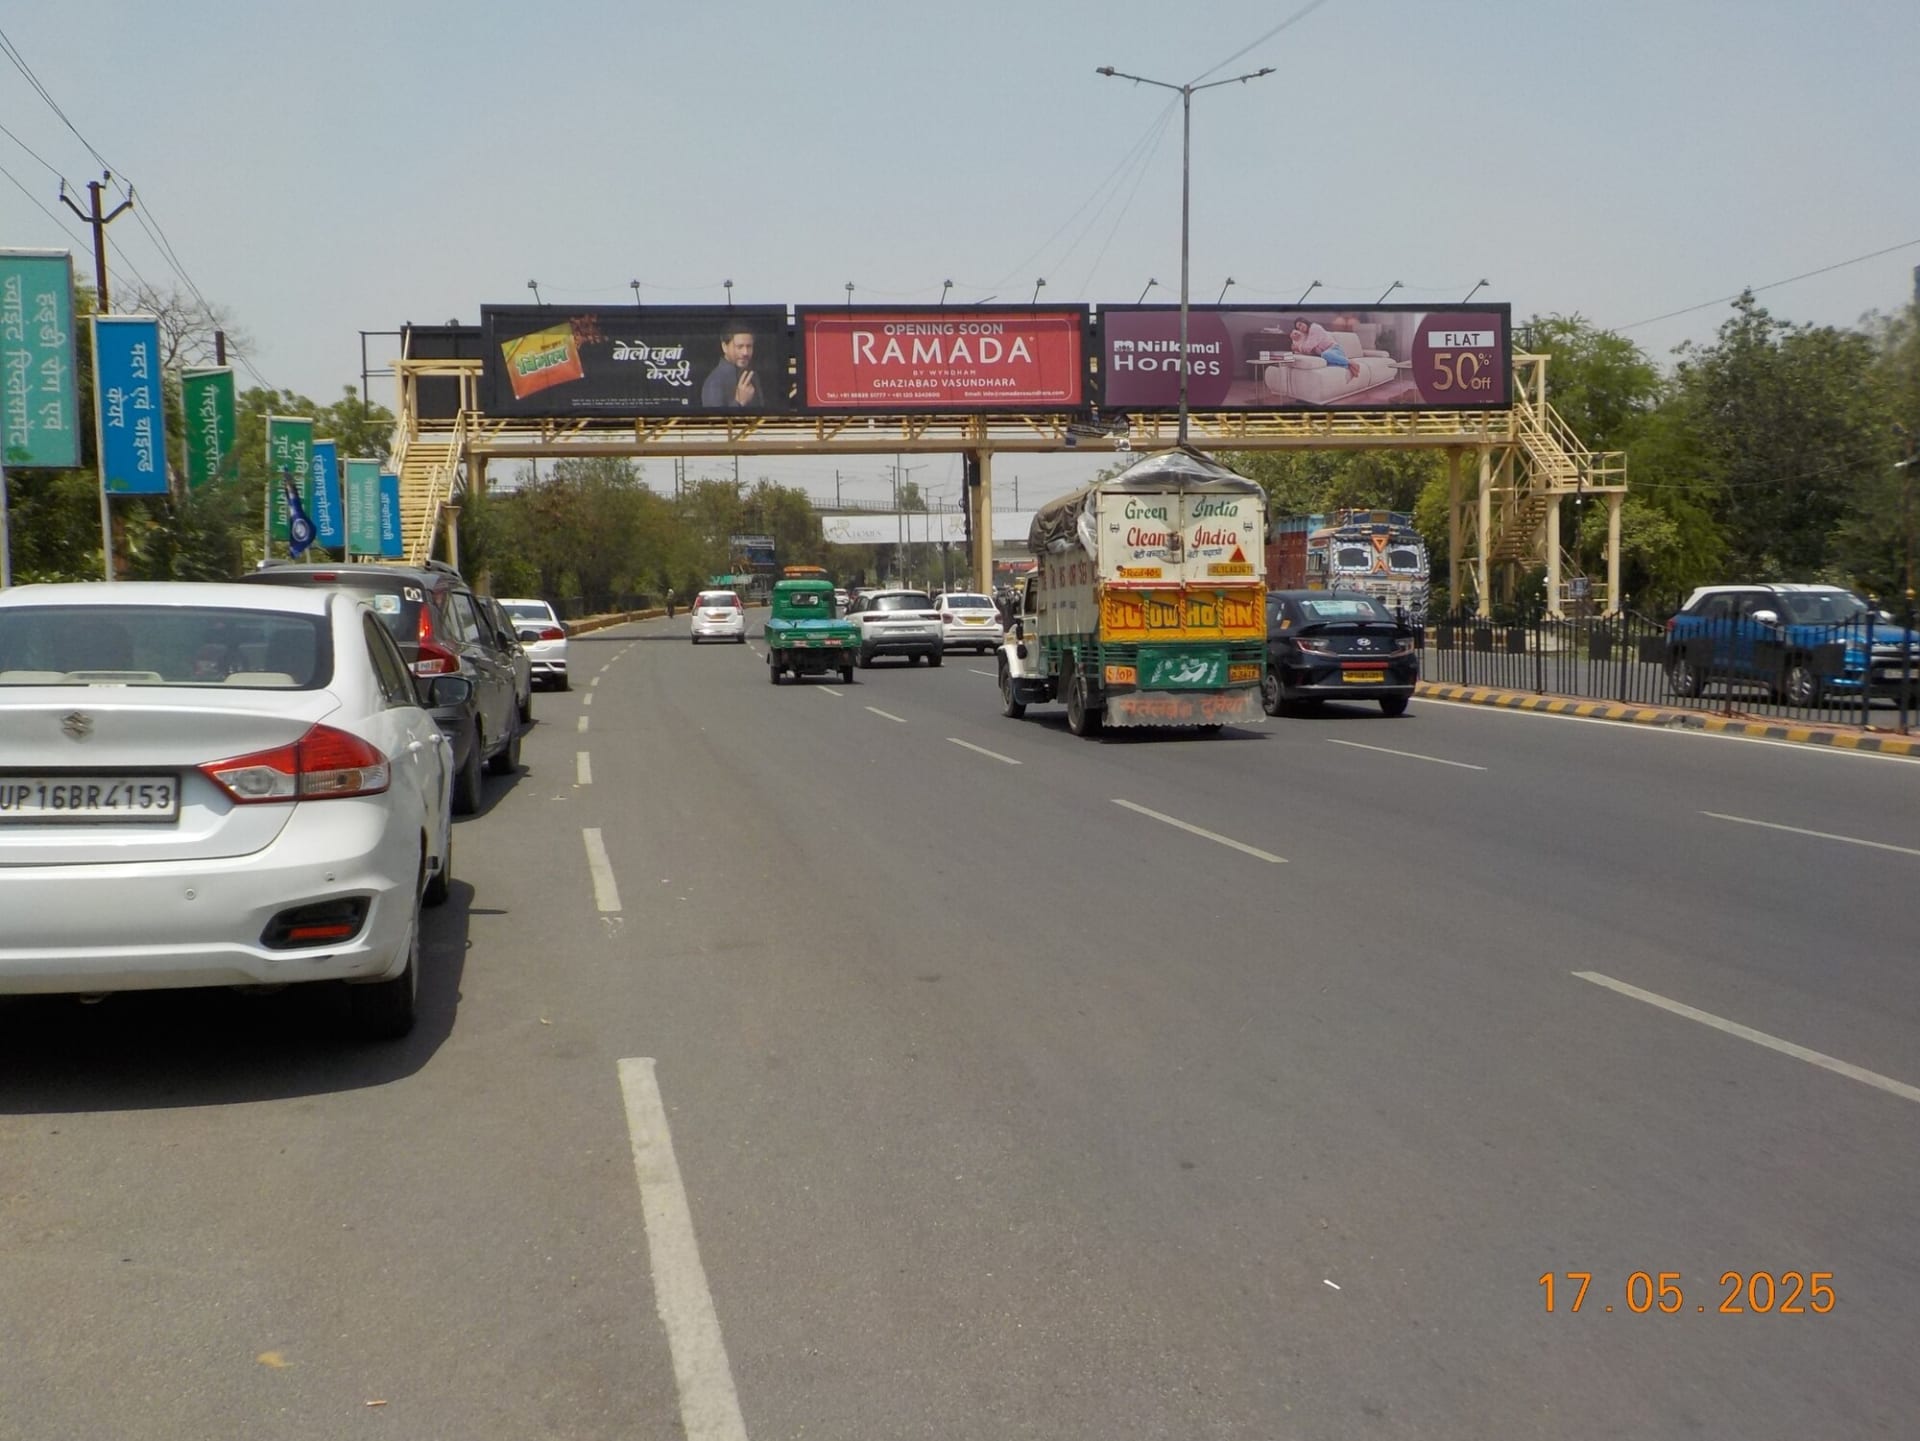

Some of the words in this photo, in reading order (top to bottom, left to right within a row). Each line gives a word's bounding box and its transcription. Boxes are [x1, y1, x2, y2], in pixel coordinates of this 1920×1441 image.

[884, 323, 954, 336] OPENING
[959, 322, 1004, 335] SOON
[1445, 333, 1480, 346] FLAT
[612, 340, 650, 361] बोलो
[852, 331, 1032, 364] RAMADA
[1137, 340, 1220, 354] Nilkmal
[130, 342, 149, 379] मदर
[644, 360, 693, 386] केसरी
[1114, 354, 1220, 375] Homes
[40, 356, 66, 392] रोग
[873, 379, 938, 388] GHAZIABAD
[941, 377, 1016, 388] VASUNDHARA
[4, 349, 36, 447] रिप्लेसमेंट
[106, 387, 129, 427] केयर
[130, 386, 155, 410] एवं
[39, 401, 68, 431] एवं
[132, 417, 154, 472] चाइल्ड
[1125, 499, 1168, 521] Green
[1192, 495, 1239, 518] India
[1127, 527, 1166, 547] Clean
[1191, 525, 1237, 549] India
[0, 785, 171, 810] UP16BR4153
